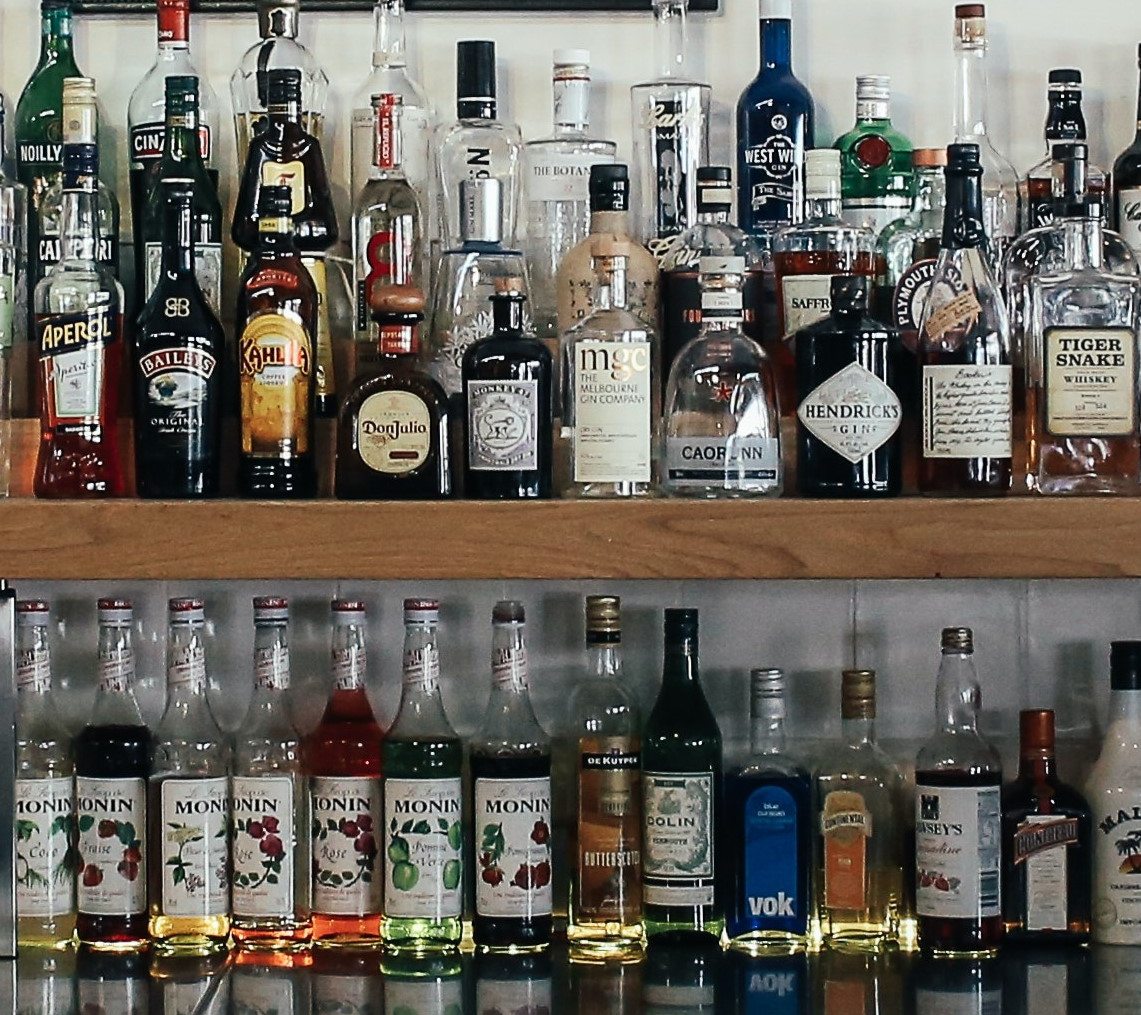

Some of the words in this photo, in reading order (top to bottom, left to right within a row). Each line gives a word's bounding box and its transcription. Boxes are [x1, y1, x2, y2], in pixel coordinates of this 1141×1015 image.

[20, 144, 62, 162] NOILLY
[744, 148, 775, 164] WEST
[42, 316, 111, 351] APEROL
[1058, 338, 1122, 352] TIGER
[580, 347, 647, 382] mgc
[1056, 353, 1125, 367] SNAKE
[580, 373, 598, 383] THE
[1063, 375, 1118, 384] WHISKEY
[580, 384, 639, 394] MELBOURNE
[580, 394, 598, 404] GIN
[599, 394, 646, 404] COMPANY
[805, 403, 899, 419] HENDRICK'S
[839, 424, 870, 435] GIN
[394, 799, 460, 814] MONIN
[485, 799, 550, 814] MONIN
[748, 891, 795, 917] vok
